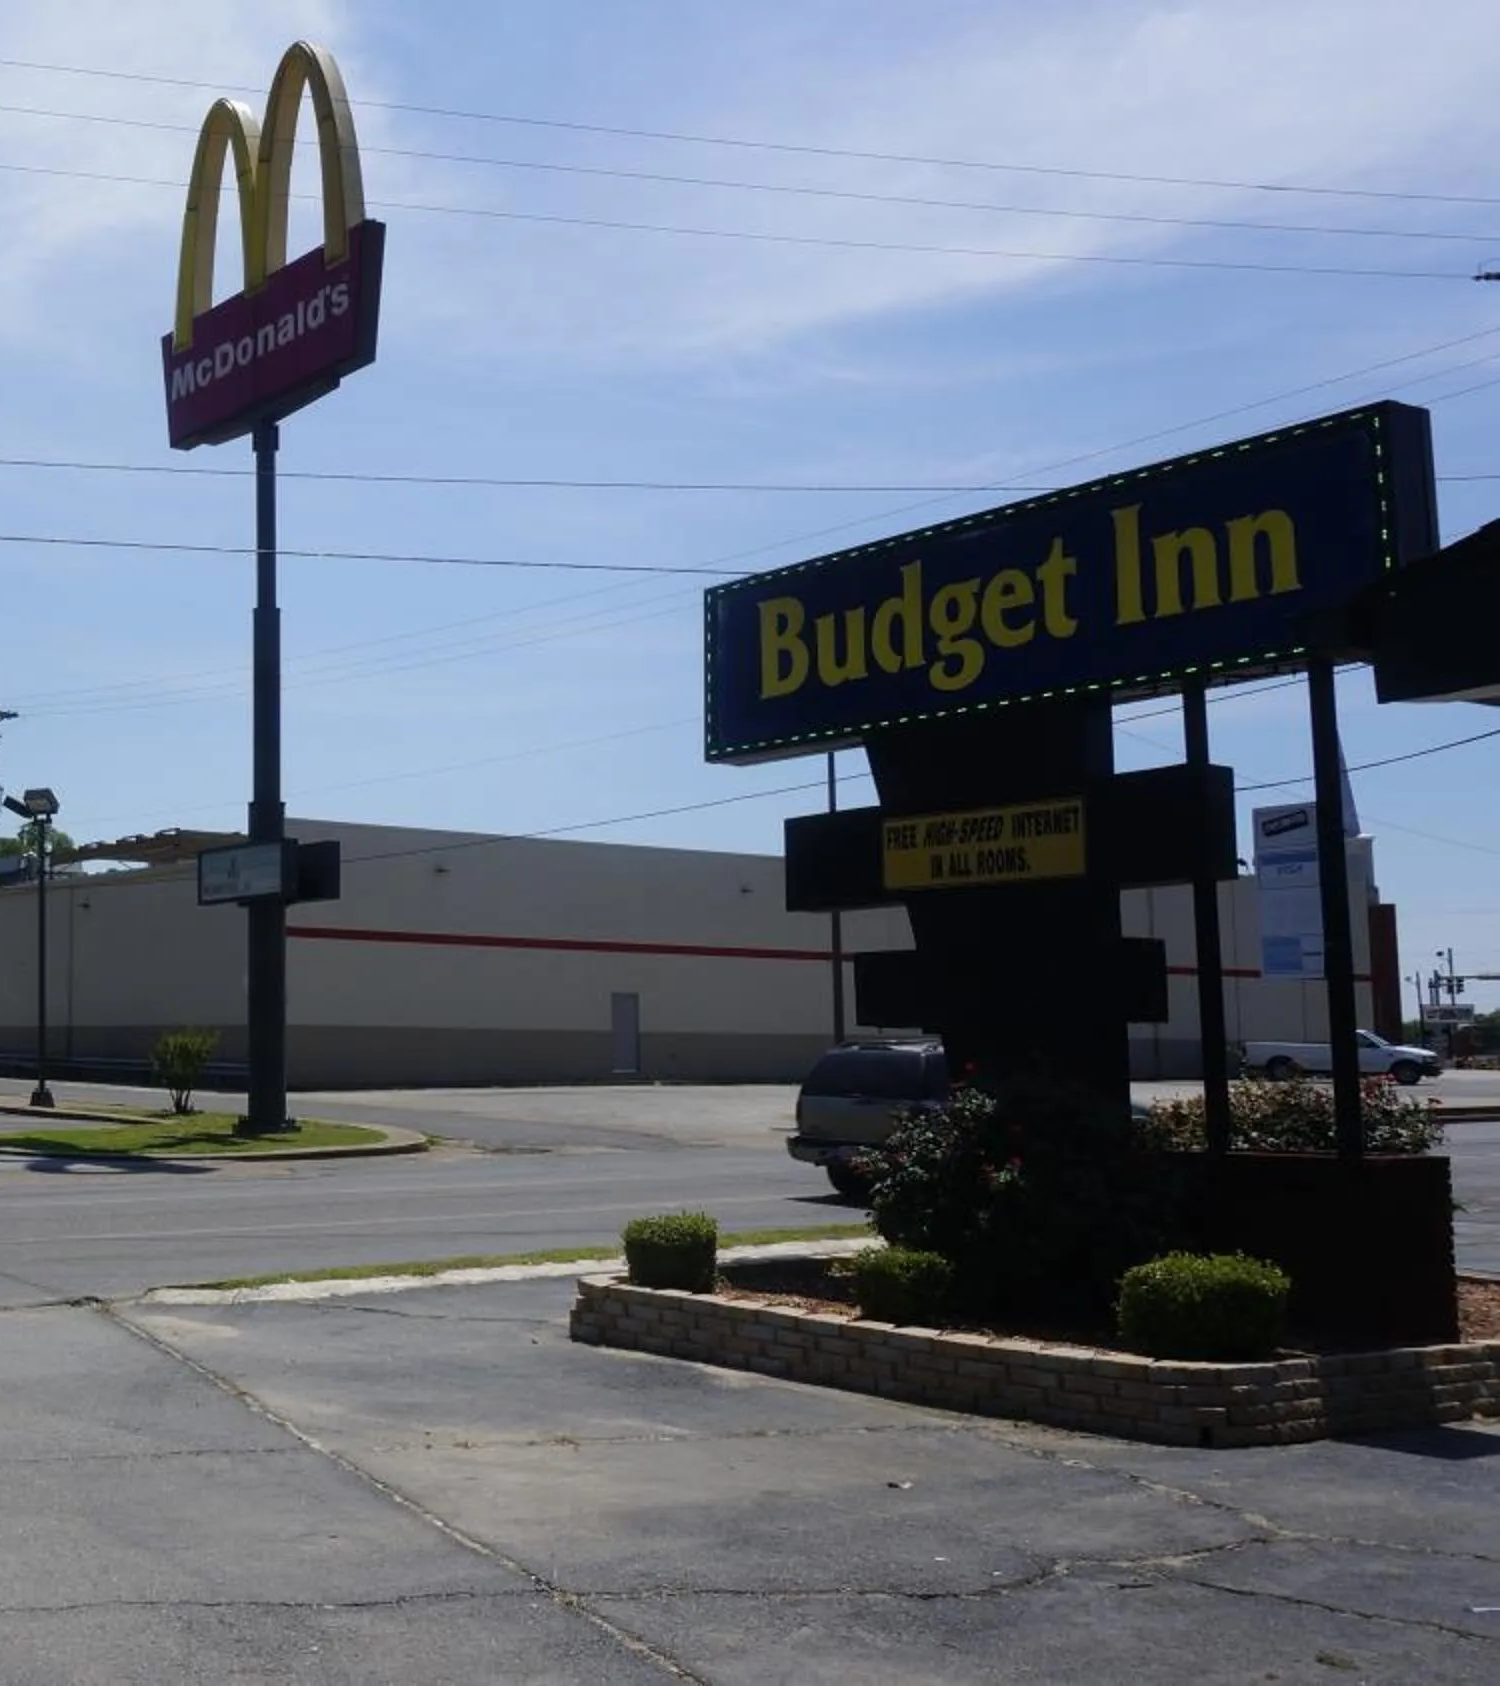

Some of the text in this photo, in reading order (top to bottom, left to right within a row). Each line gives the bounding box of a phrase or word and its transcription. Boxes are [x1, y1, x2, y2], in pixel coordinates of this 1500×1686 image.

[171, 282, 350, 401] McDonald's
[757, 503, 1303, 699] Budget Inn
[887, 807, 1079, 849] FREE HIGH-SPEED INTERNET
[931, 847, 1031, 879] IN ALL ROOMS.
